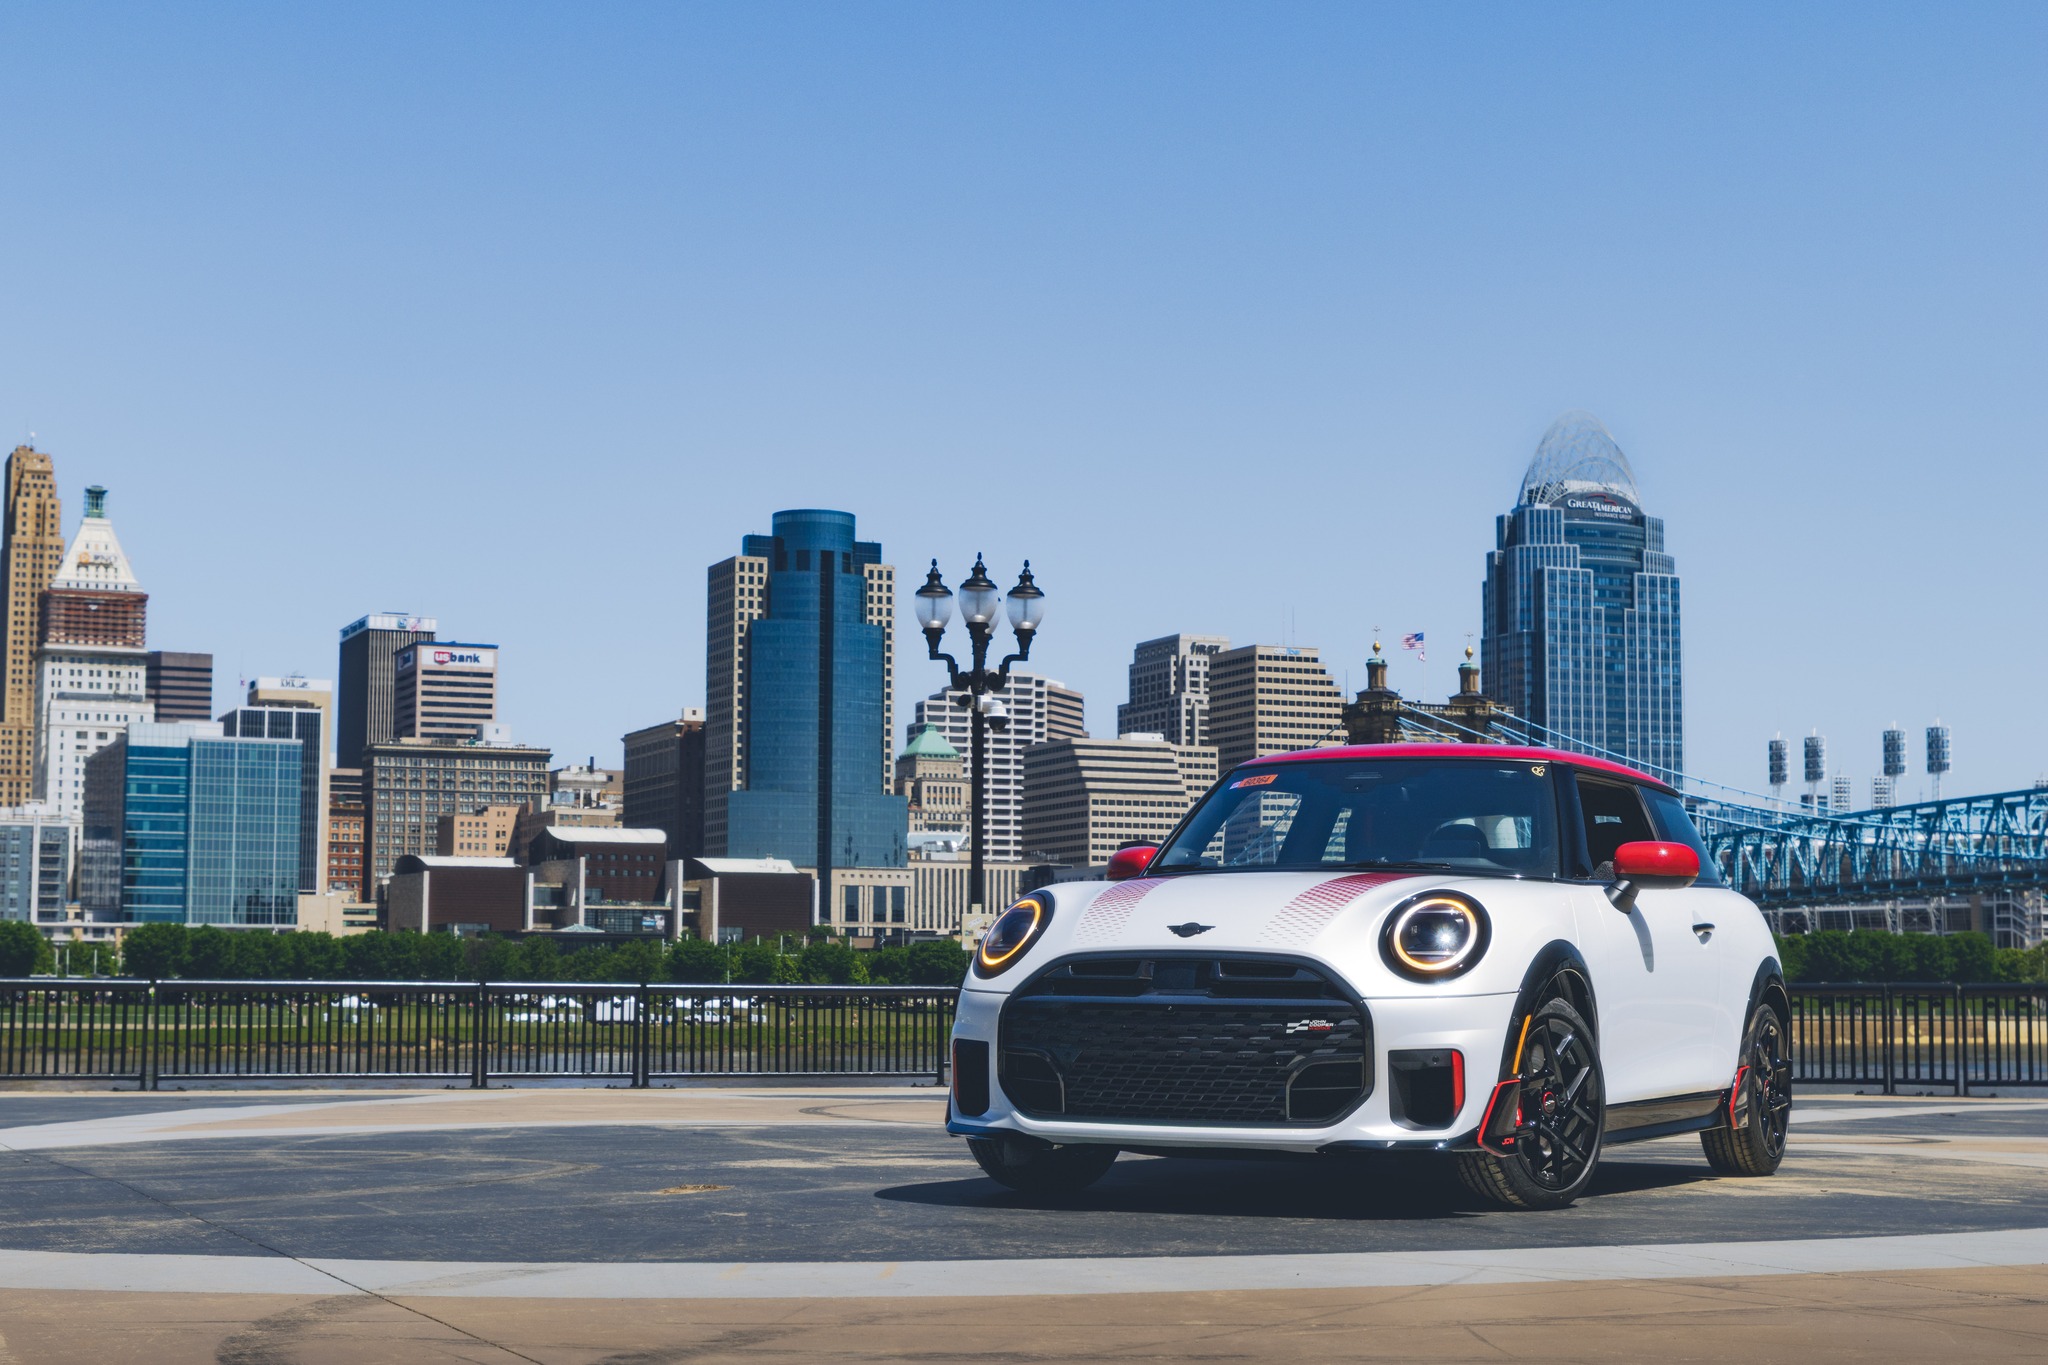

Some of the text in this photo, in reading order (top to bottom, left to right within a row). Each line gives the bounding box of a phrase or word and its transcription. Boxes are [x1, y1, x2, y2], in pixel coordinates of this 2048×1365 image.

[1567, 498, 1632, 514] GREAT AMERICAN
[1502, 1137, 1514, 1145] JCW
